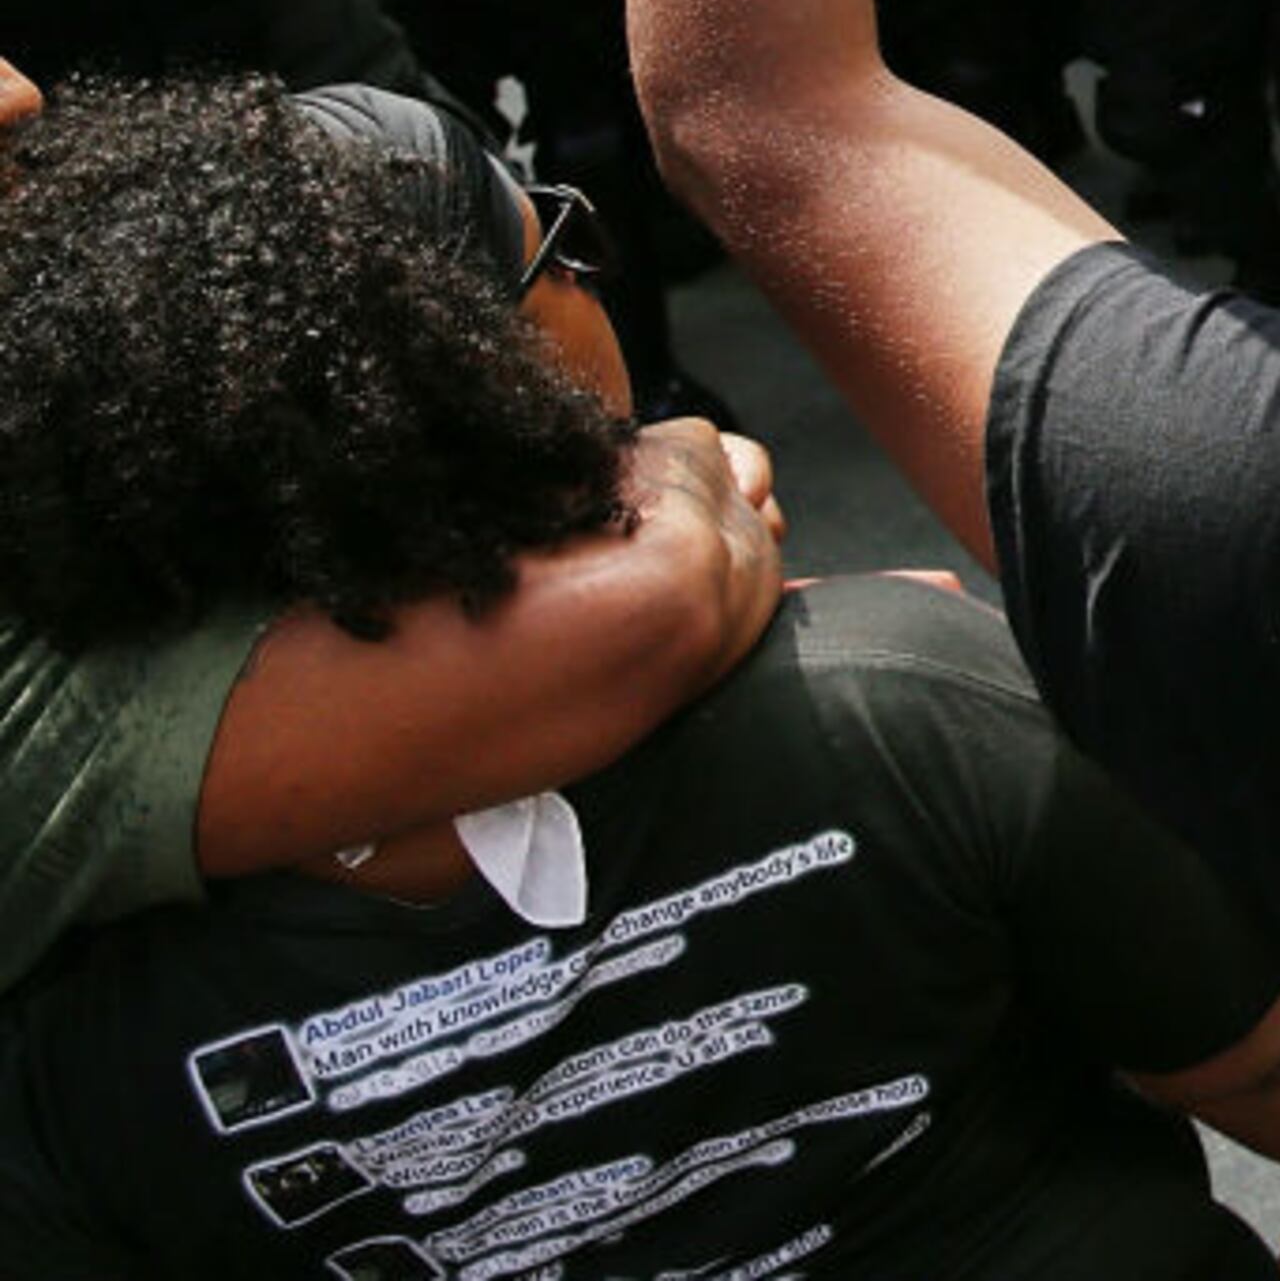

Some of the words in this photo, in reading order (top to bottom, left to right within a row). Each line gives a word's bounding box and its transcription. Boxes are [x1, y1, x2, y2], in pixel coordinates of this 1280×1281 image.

[305, 1000, 384, 1045] Abdul
[479, 941, 546, 983] Lopez
[313, 1042, 374, 1075] Man
[378, 1019, 432, 1051] with
[437, 968, 564, 1027] knowledge
[609, 896, 696, 941] change
[700, 848, 811, 905] anybody's
[814, 835, 850, 862] life
[618, 1036, 661, 1058] can
[662, 1024, 692, 1047] do
[696, 1005, 734, 1030] the
[701, 1036, 729, 1059] all
